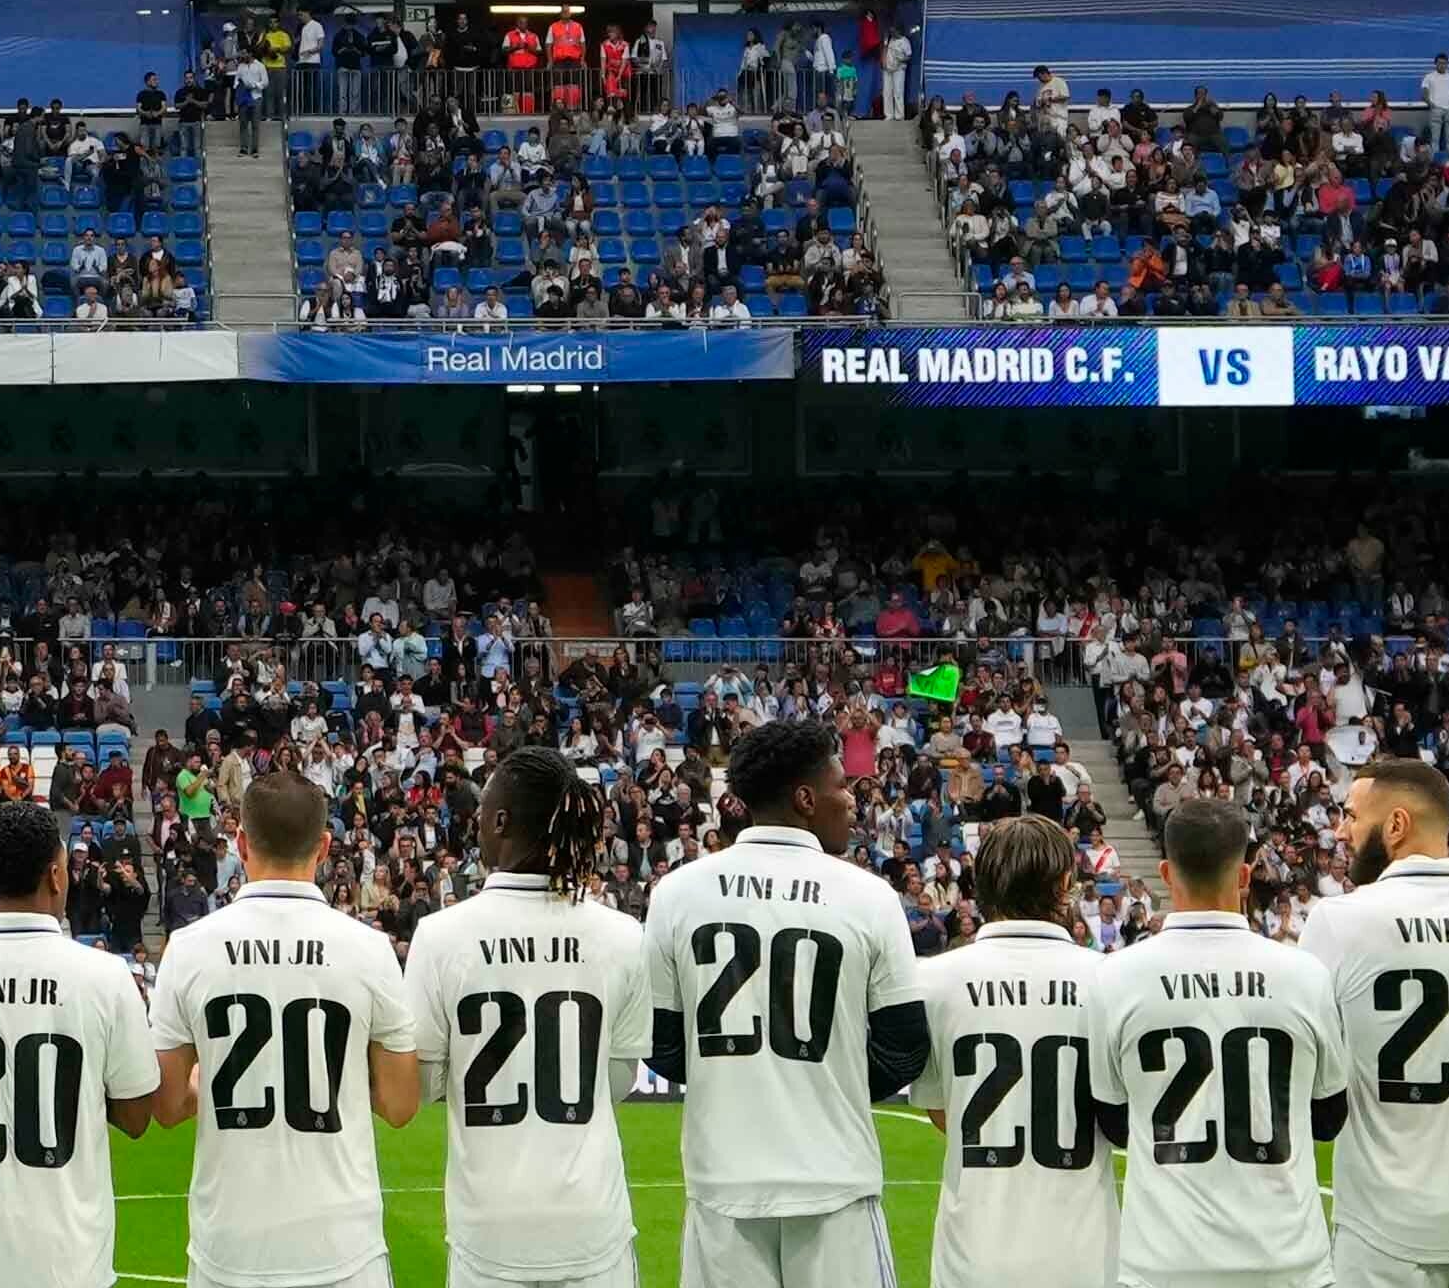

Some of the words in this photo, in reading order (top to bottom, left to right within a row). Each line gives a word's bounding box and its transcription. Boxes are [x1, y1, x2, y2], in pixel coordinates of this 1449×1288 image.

[429, 347, 489, 371] Real
[503, 345, 601, 370] Madrid
[823, 349, 908, 382] REAL
[919, 348, 1053, 382] MADRID
[1066, 347, 1133, 382] C.F.
[1199, 349, 1250, 385] VS
[1316, 346, 1407, 381] RAYO
[719, 875, 772, 899] VINI
[781, 878, 826, 905] JR.
[225, 940, 280, 965] VINI
[288, 940, 328, 966] JR.
[480, 937, 535, 964] VINI
[544, 937, 585, 963] JR.
[23, 978, 63, 1005] JR.
[691, 922, 843, 1063] 20
[966, 981, 1026, 1007] VINI
[1041, 981, 1082, 1006] JR.
[1161, 973, 1219, 1000] VINI
[1228, 972, 1271, 999] JR.
[204, 993, 351, 1133] 20
[457, 991, 603, 1127] 20
[952, 1033, 1093, 1170] 20
[1137, 1026, 1294, 1165] 20
